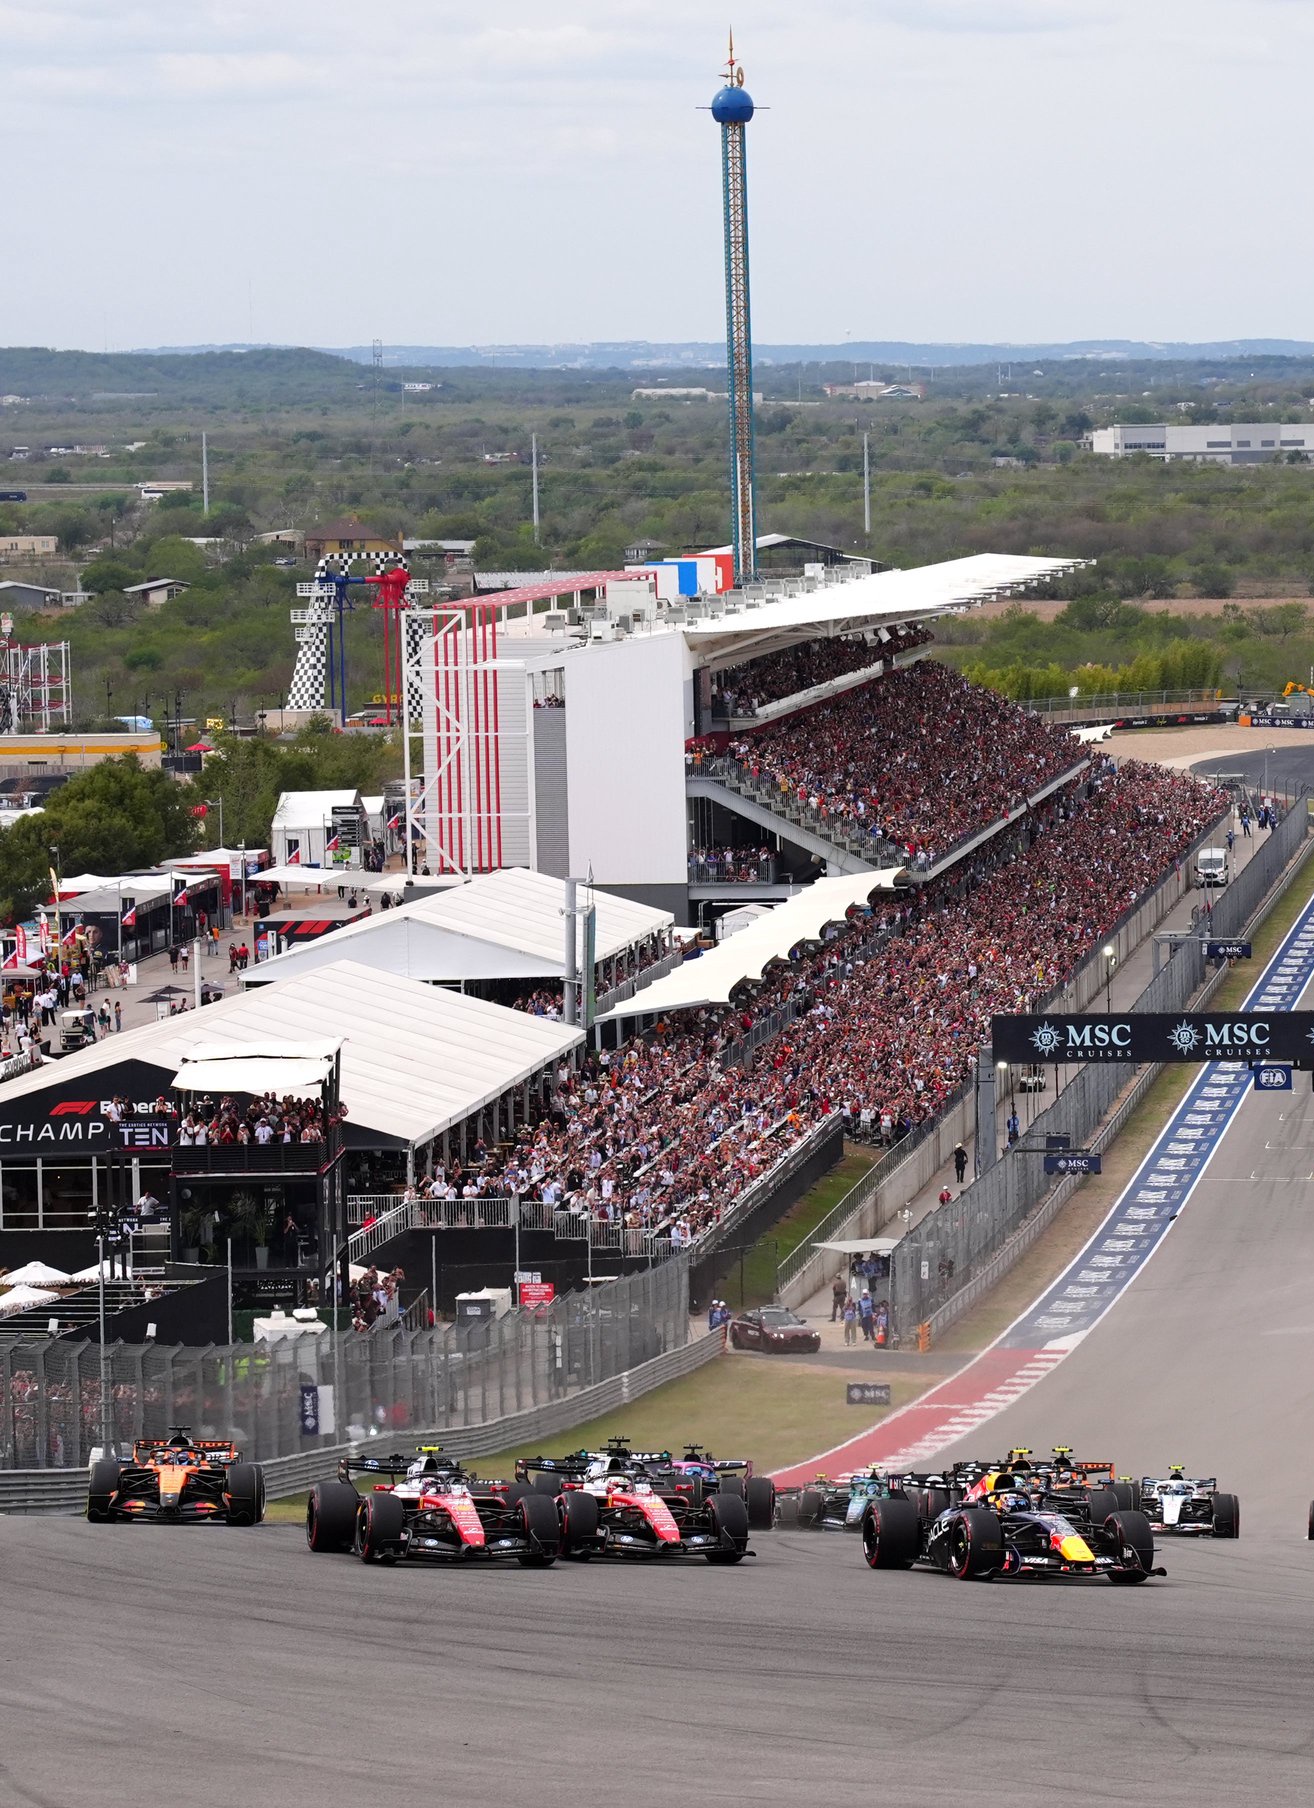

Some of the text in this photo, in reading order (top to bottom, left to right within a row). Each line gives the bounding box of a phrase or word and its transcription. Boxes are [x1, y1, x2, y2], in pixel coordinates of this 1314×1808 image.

[1067, 1025, 1131, 1047] MSC
[1205, 1023, 1270, 1045] MSC
[0, 1122, 110, 1142] CHAMP
[119, 1128, 168, 1146] TEN
